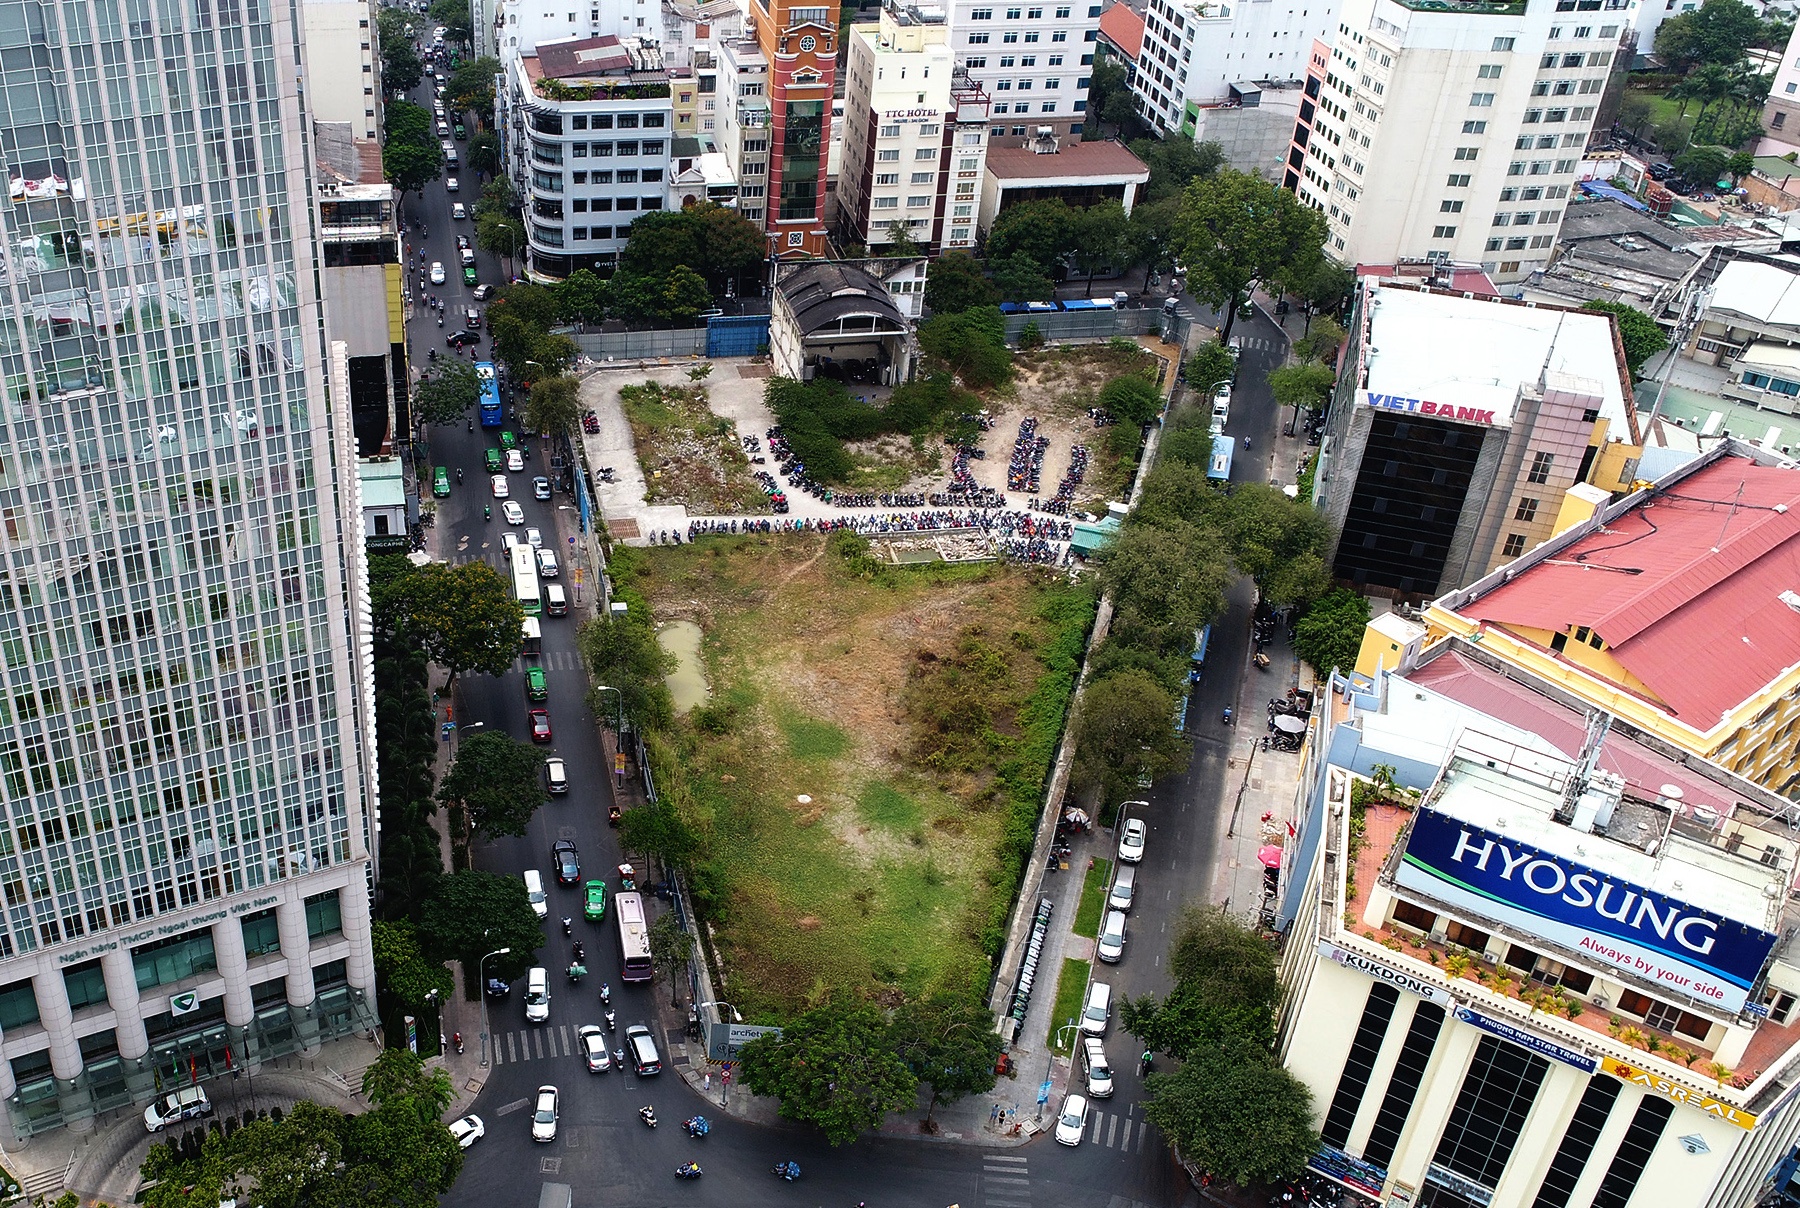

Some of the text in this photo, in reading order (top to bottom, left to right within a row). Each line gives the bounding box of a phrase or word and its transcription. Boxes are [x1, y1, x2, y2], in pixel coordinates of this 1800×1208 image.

[885, 109, 939, 118] TTC HOTEL
[1367, 392, 1495, 424] VIETBANK
[1450, 829, 1718, 956] HYOSUNG
[120, 929, 154, 945] TMCP
[254, 895, 277, 907] Nam
[1345, 954, 1434, 997] KUKDONG
[1579, 936, 1724, 1000] Always by your side
[731, 1029, 763, 1038] archety
[1515, 1031, 1534, 1043] NAM
[1535, 1038, 1557, 1053] STAR
[1559, 1048, 1590, 1067] TRAVEL
[1632, 1074, 1740, 1123] ASREAL
